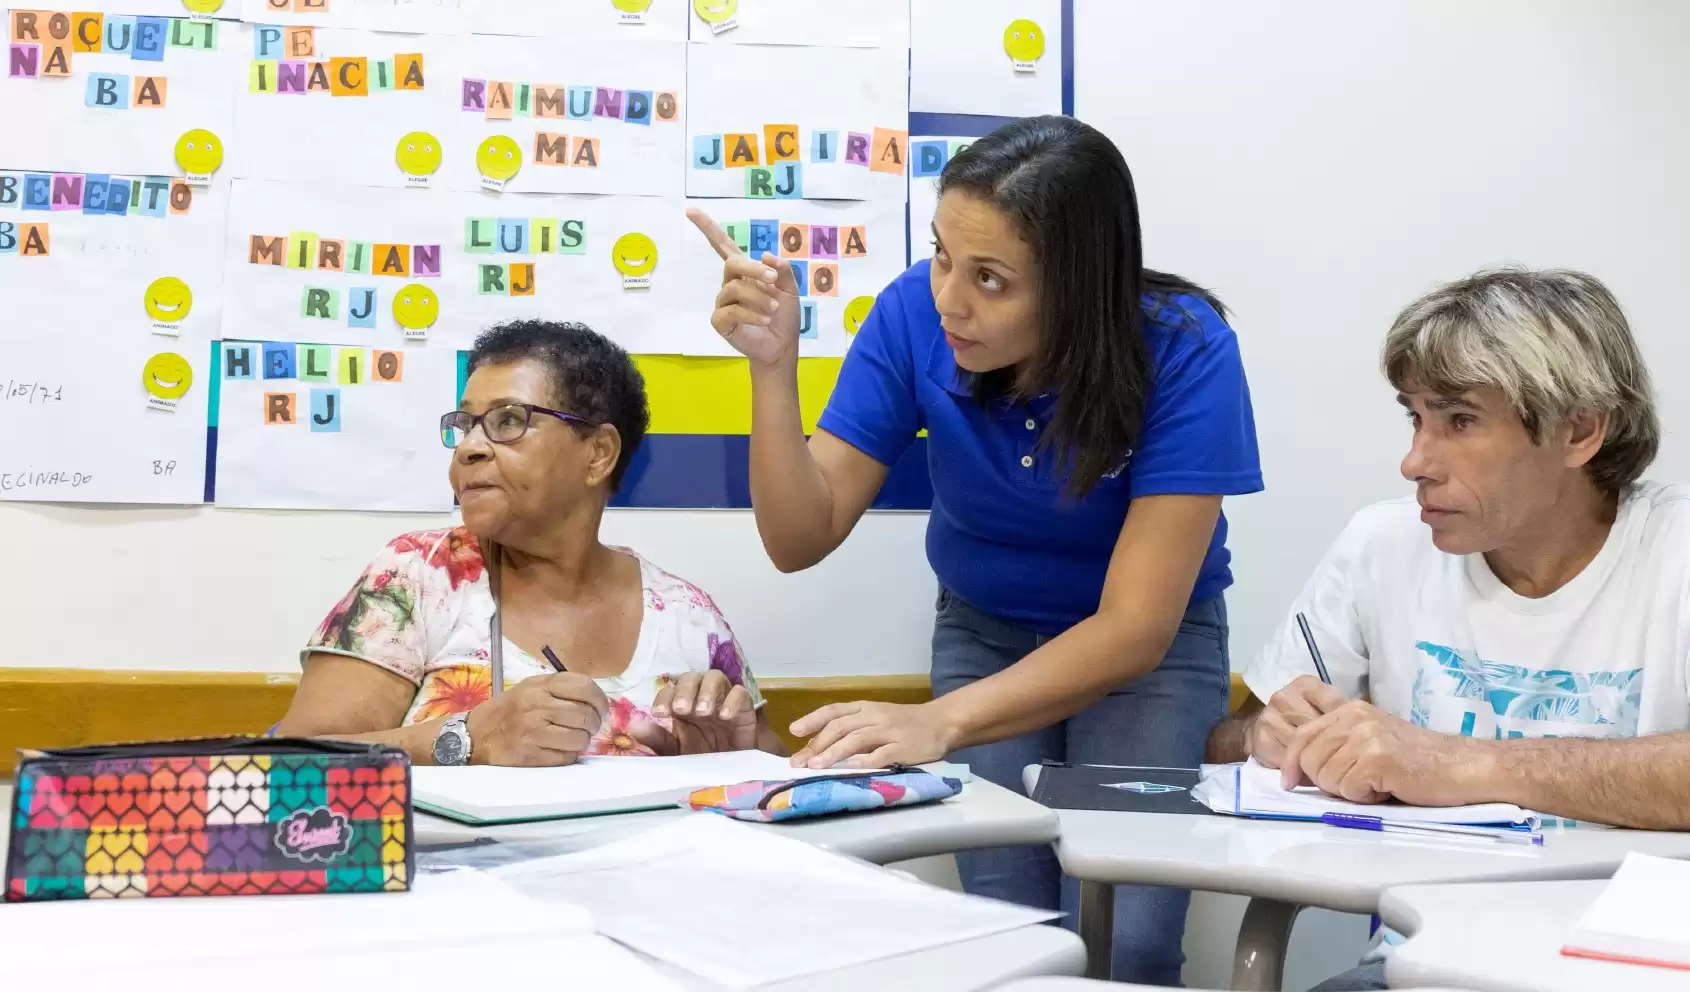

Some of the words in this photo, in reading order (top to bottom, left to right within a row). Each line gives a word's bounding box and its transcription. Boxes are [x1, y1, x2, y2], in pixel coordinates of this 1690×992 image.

[259, 28, 315, 57] PE
[11, 46, 69, 76] NA
[256, 60, 425, 92] INACIA
[95, 77, 161, 106] BA
[463, 79, 677, 120] RAIMUNDO
[537, 133, 598, 168] MA
[700, 131, 902, 167] JACIRA
[749, 164, 796, 197] RJ
[470, 219, 584, 253] LUIS
[250, 235, 440, 276] MIRIAN
[482, 264, 535, 294] RJ
[305, 289, 374, 320] RJ
[226, 347, 402, 385] HELIO
[148, 398, 176, 408] ANIMADO
[267, 393, 336, 426] RJ
[152, 459, 177, 476] BA
